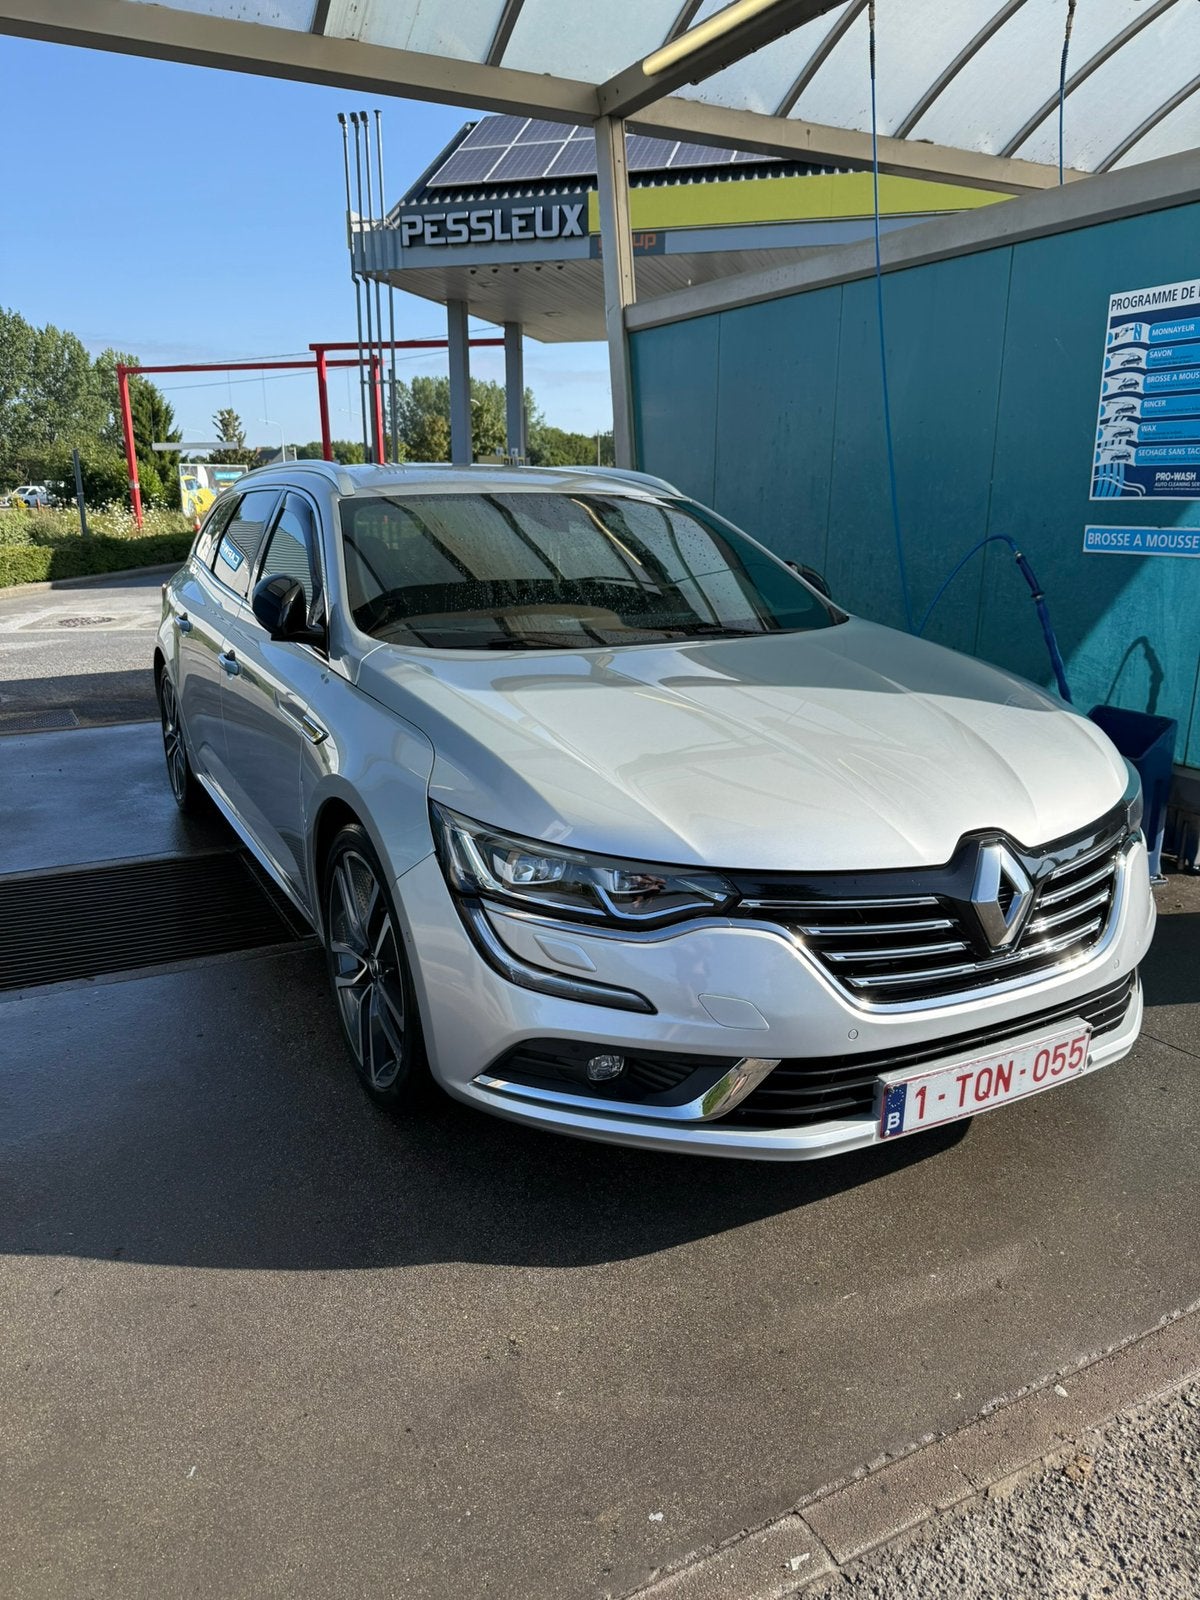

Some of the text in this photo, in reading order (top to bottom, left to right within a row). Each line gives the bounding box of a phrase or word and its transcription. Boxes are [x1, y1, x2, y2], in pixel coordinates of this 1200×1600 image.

[401, 203, 584, 248] PESSLEUX
[1111, 288, 1178, 311] PROGRAMME
[1181, 286, 1196, 299] DE
[1152, 324, 1195, 336] MONNAYEUR
[1149, 349, 1172, 359] SAVON
[1146, 374, 1171, 384] BROSSE
[1171, 373, 1178, 381] A
[1143, 400, 1166, 408] RINCER
[1141, 424, 1157, 432] WAX
[1138, 448, 1167, 457] SECHAGE
[1168, 448, 1185, 456] SANS
[1087, 532, 1200, 549] BROSSE A MOUSSE
[886, 1112, 901, 1130] B
